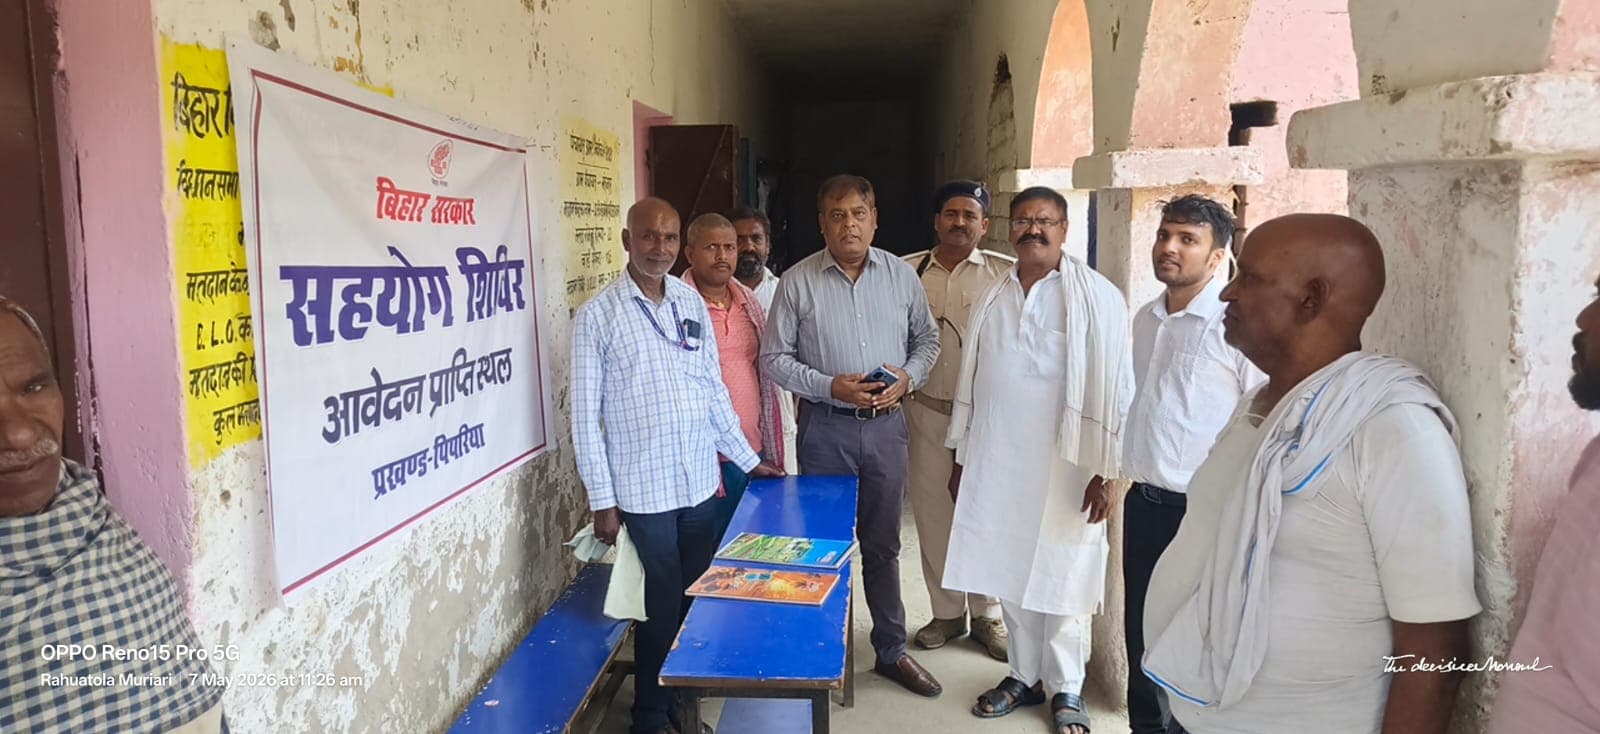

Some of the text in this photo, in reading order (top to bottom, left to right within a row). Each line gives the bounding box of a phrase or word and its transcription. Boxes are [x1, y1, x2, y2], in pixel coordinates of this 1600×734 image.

[376, 176, 475, 224] बिहार सरकार
[280, 245, 525, 346] सहयोग शिविर
[322, 367, 426, 444] आवेदन
[429, 347, 476, 418] प्राप्ति
[477, 348, 512, 391] स्थल
